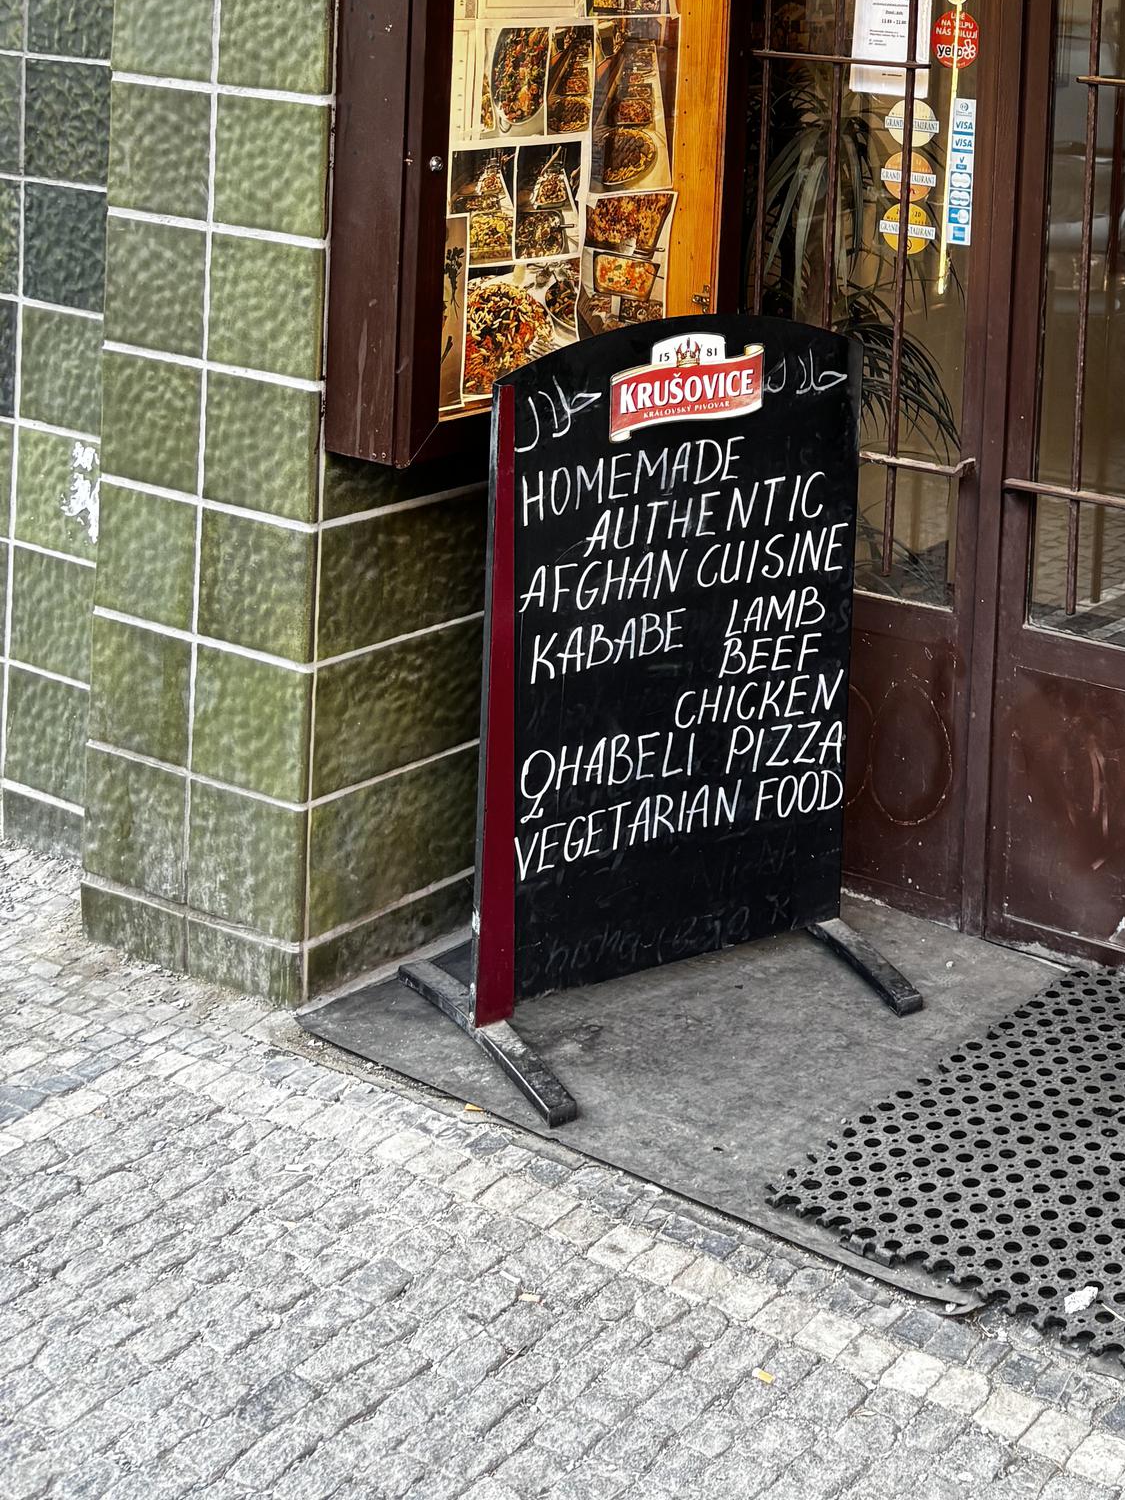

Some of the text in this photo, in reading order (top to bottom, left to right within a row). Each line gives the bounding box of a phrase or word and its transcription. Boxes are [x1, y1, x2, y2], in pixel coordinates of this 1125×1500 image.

[941, 19, 951, 27] NA
[954, 137, 973, 148] VISA
[955, 120, 973, 130] VISA
[659, 347, 718, 363] 15 81
[620, 368, 754, 414] KRUŠOVICE
[643, 400, 730, 419] KRÁLOVSKÝ PIVOVAR
[521, 436, 745, 526] HOMEMADE
[584, 471, 827, 557] AUTHENTIC
[519, 522, 849, 614] AFGHAN CUISINE
[530, 586, 826, 685] KABABE LAMB
[717, 633, 822, 679] BEEF
[674, 668, 844, 729] CHICKEN
[725, 720, 843, 774] PIZZA
[514, 770, 844, 881] VEGETARIAN FOOD
